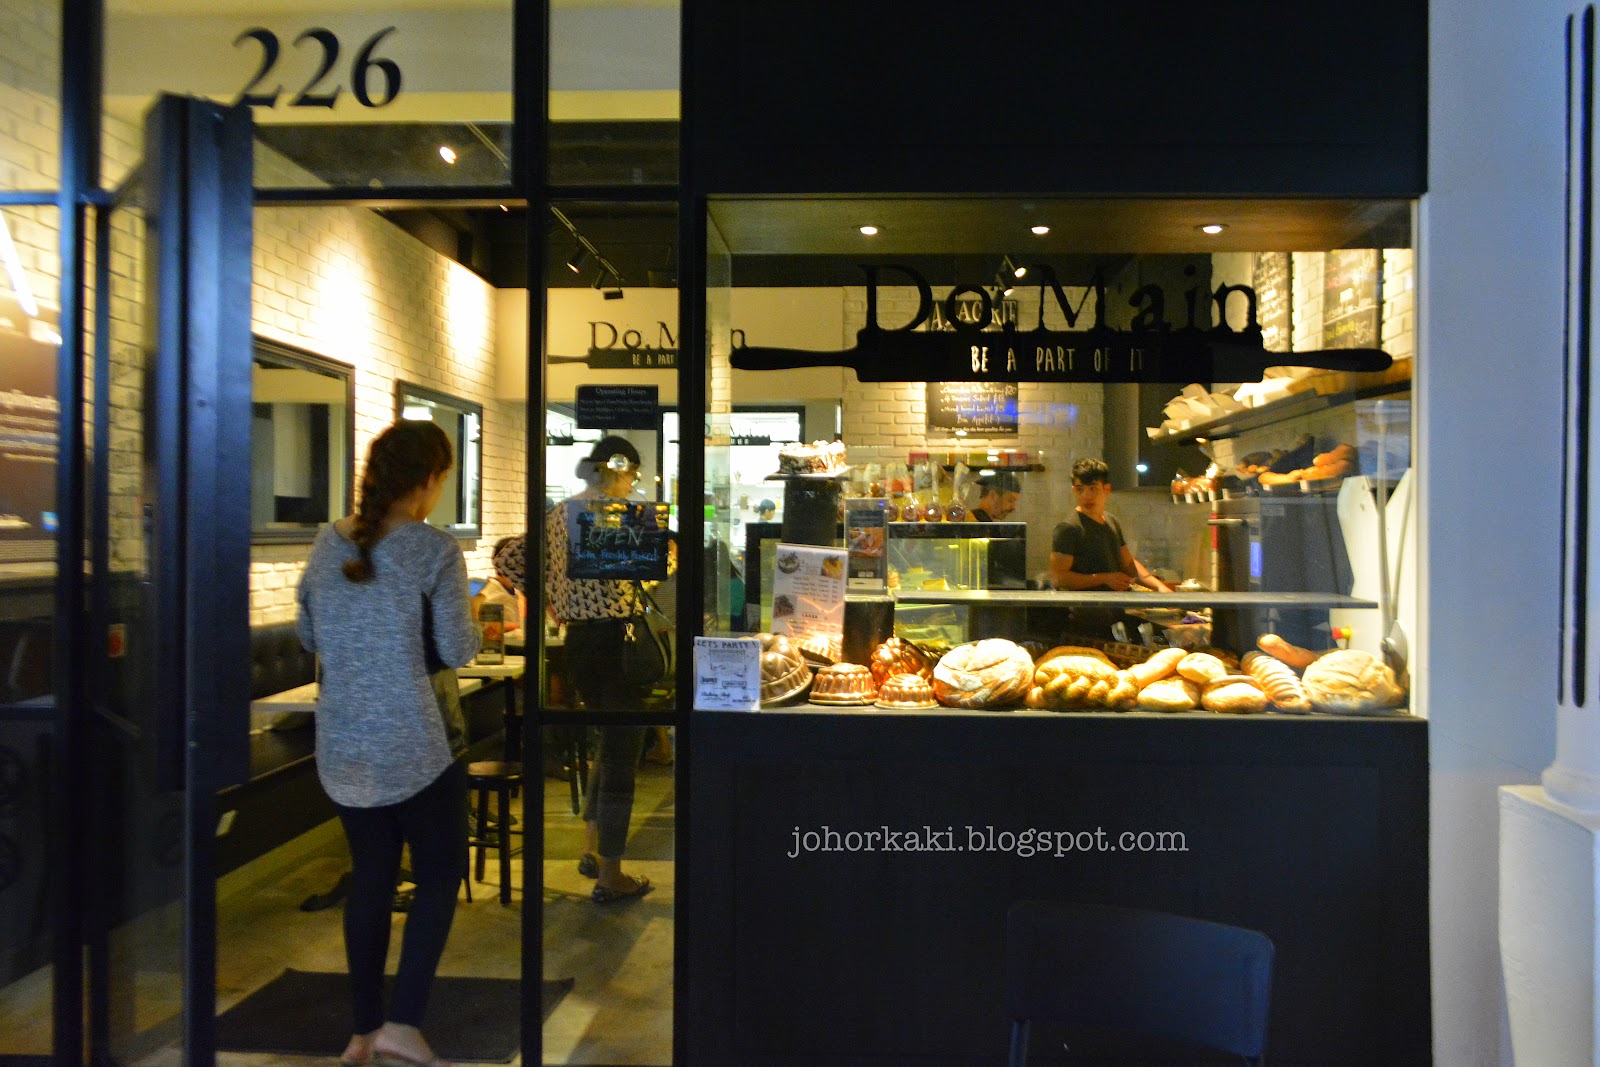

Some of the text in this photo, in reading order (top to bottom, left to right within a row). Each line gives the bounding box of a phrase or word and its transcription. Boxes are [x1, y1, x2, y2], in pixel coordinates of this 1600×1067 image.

[231, 26, 402, 109] 226
[632, 353, 675, 366] BE A PART
[971, 345, 1146, 373] BE A PART OF IT
[589, 525, 645, 546] OPEN
[722, 641, 748, 649] PARTY
